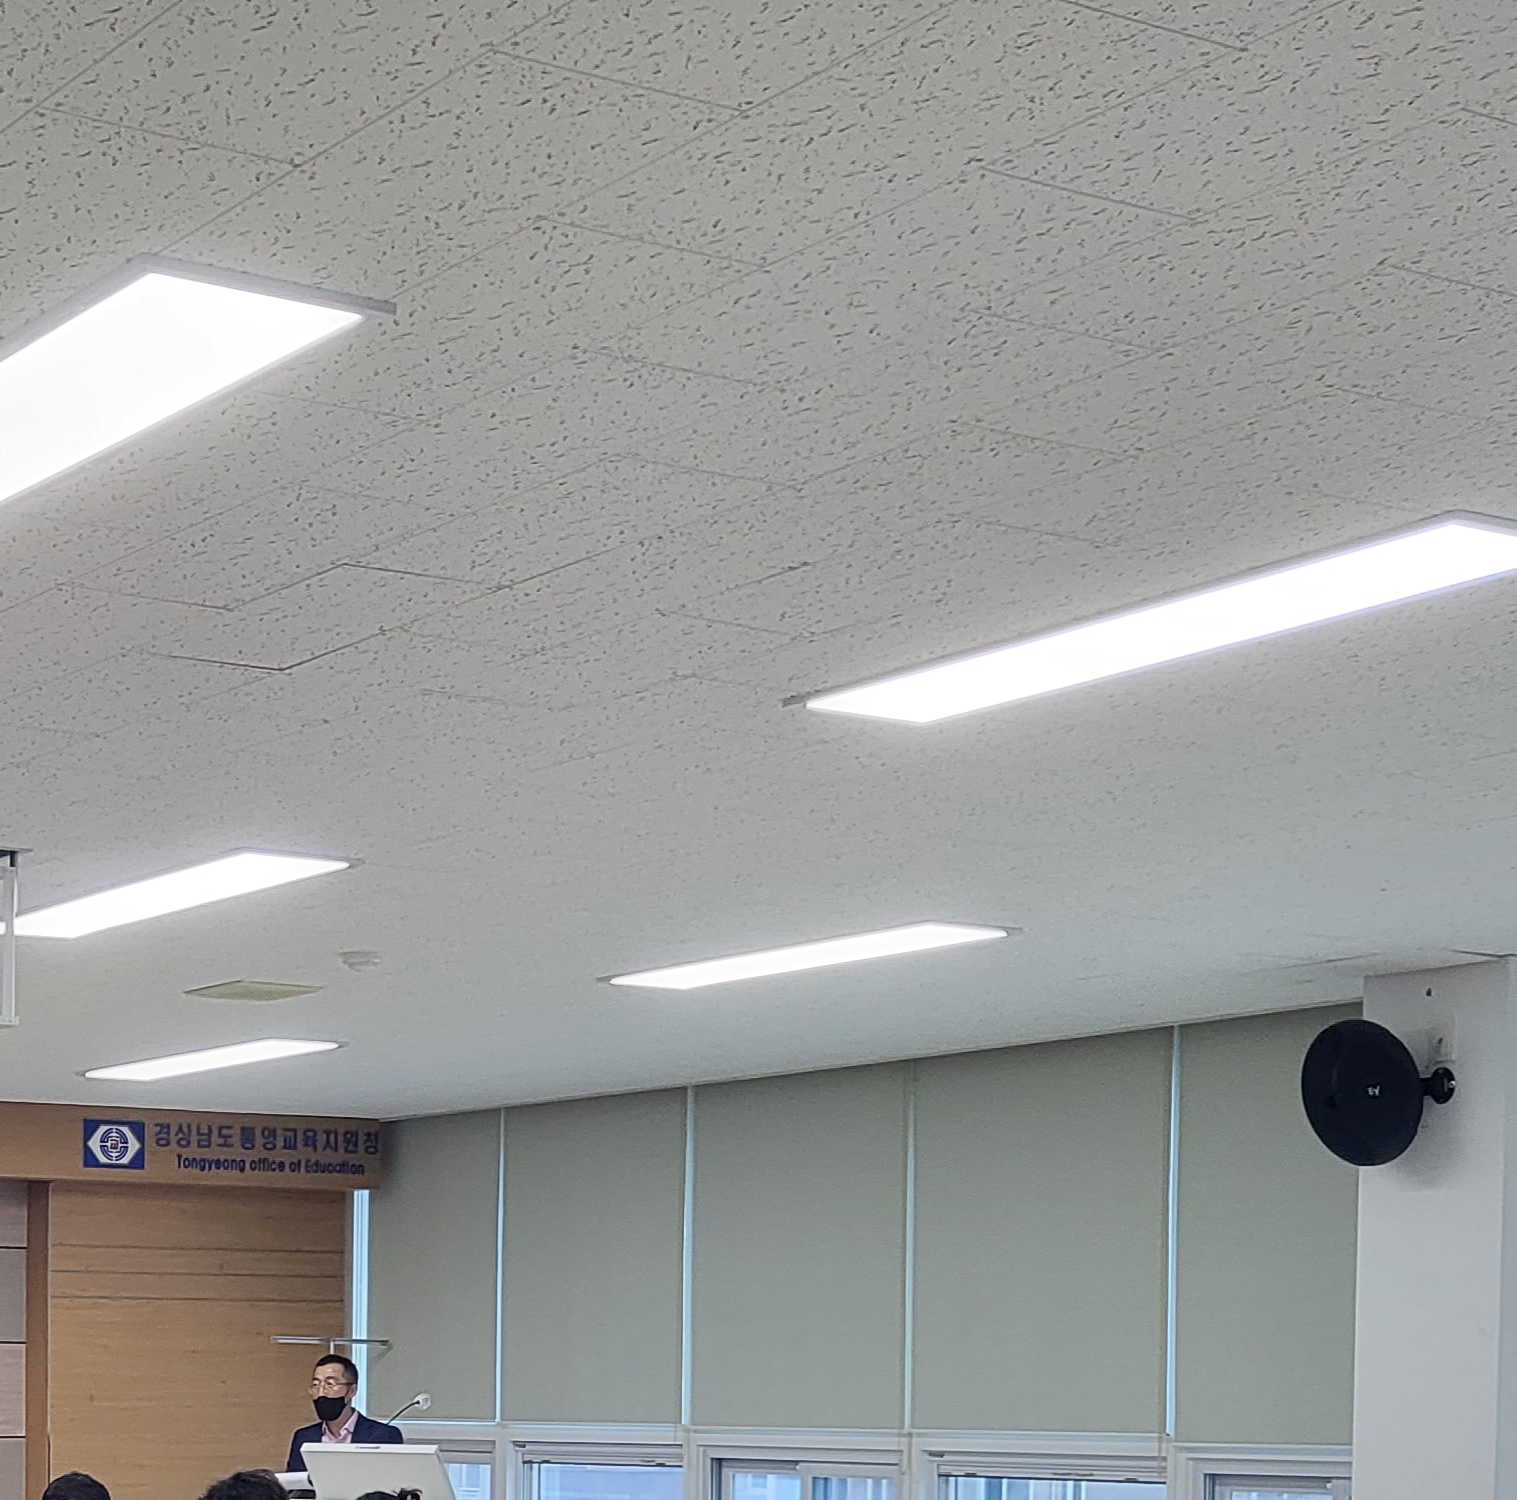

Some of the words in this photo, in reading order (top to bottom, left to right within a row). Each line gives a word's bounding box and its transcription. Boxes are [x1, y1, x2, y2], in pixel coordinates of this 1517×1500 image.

[154, 1121, 380, 1156] 경상남도통영교육지원청
[176, 1153, 246, 1173] Tongyeong
[249, 1158, 285, 1173] office
[289, 1159, 302, 1174] of
[304, 1160, 365, 1176] Education
